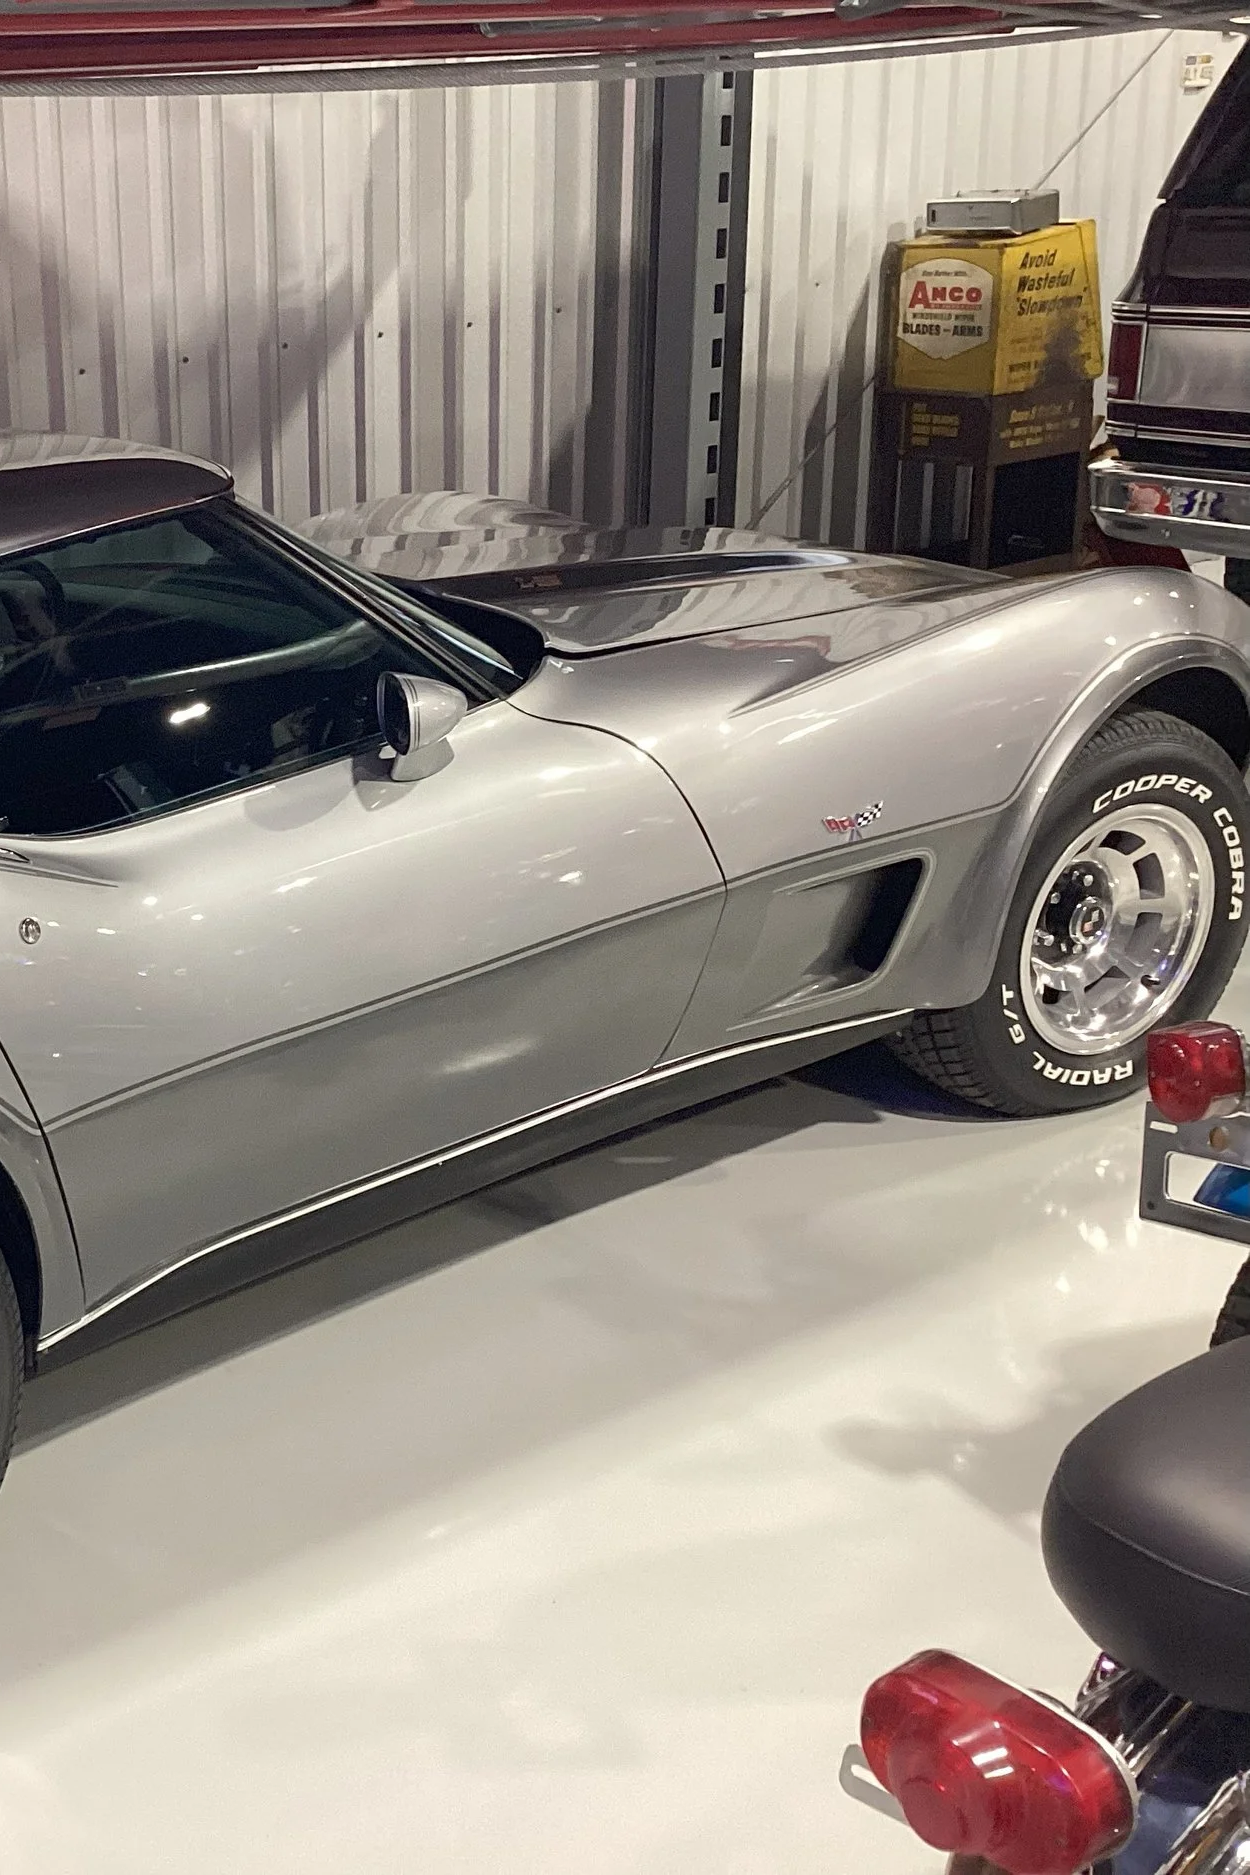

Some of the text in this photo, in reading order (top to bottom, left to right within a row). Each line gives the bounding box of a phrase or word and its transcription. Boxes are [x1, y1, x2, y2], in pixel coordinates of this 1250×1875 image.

[1019, 249, 1057, 270] Avoid
[1017, 267, 1075, 293] Wasteful
[903, 322, 941, 336] BLADES
[952, 325, 983, 336] ARMS
[1092, 774, 1245, 920] COOPER COBRA
[1001, 983, 1133, 1087] RADIAL G/T
